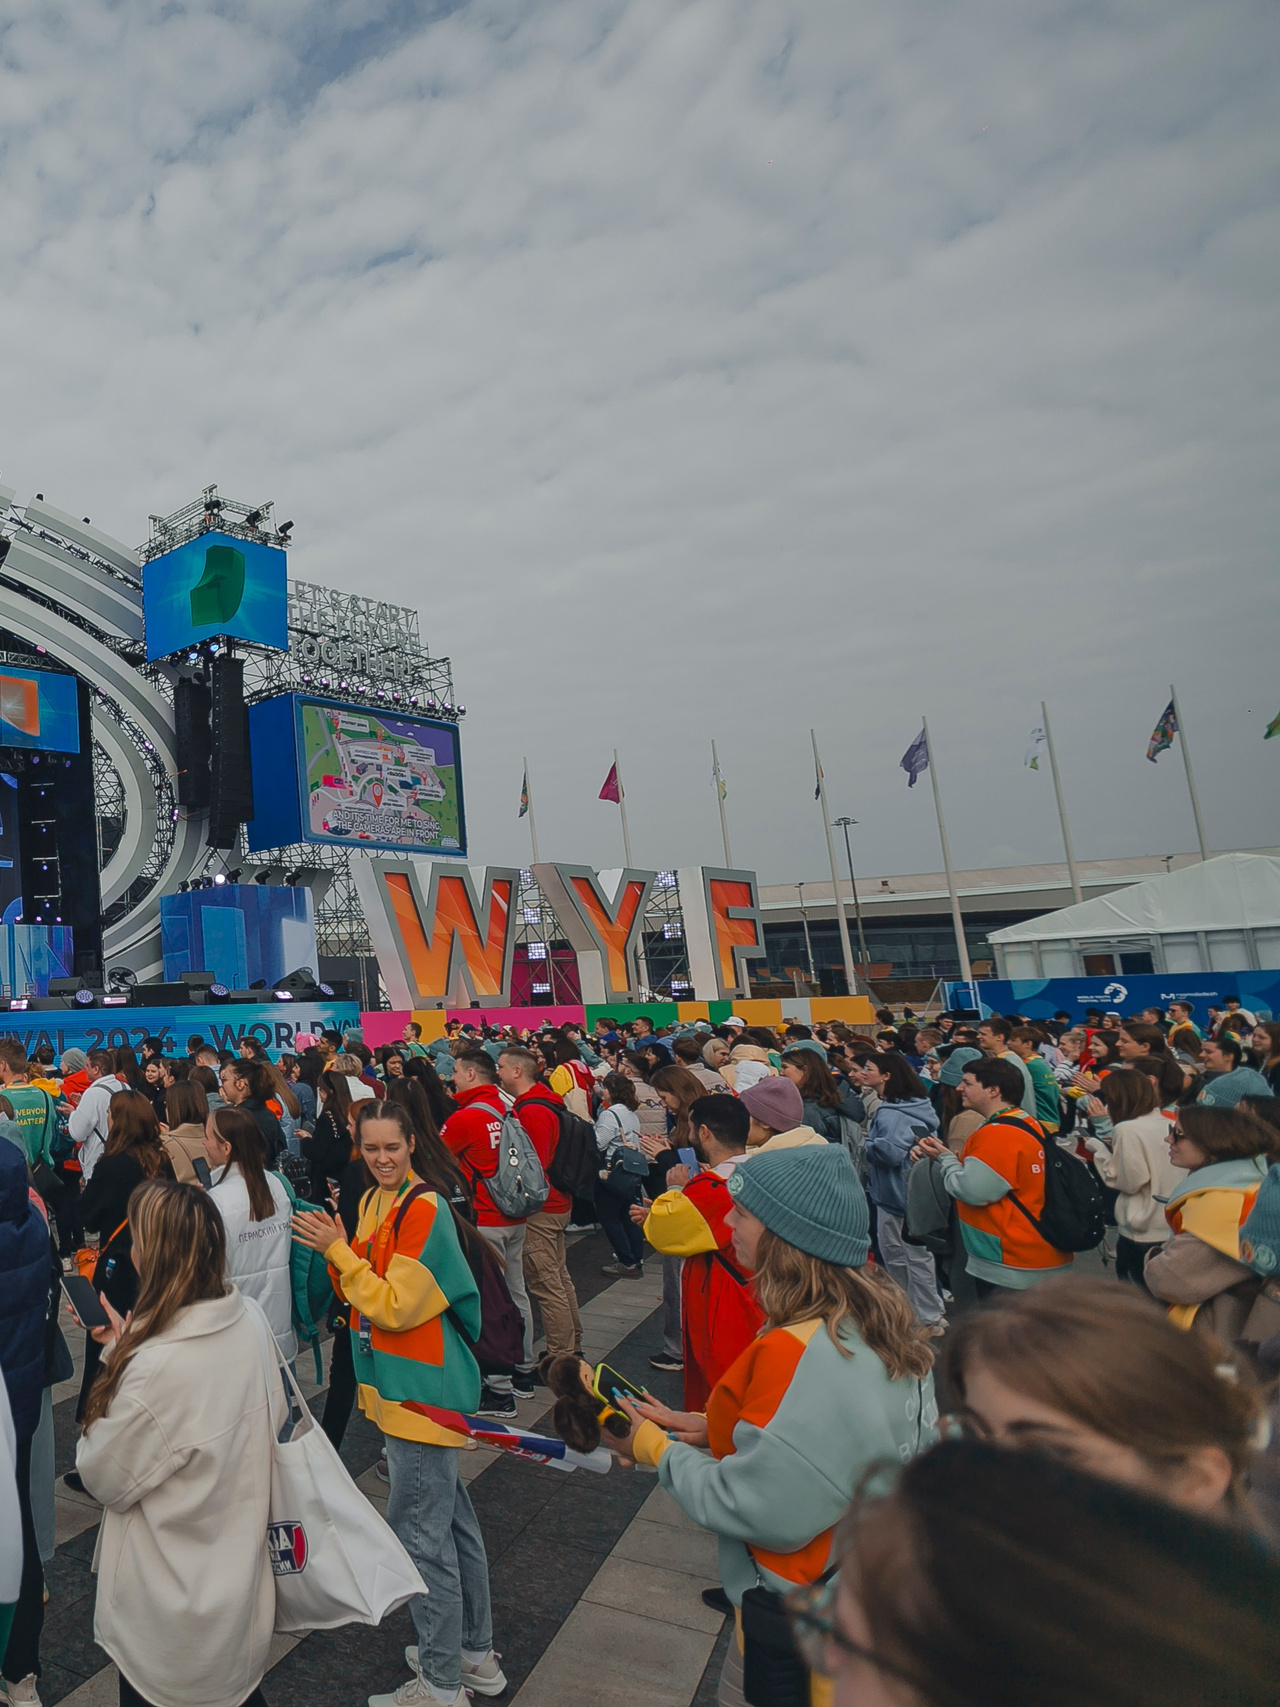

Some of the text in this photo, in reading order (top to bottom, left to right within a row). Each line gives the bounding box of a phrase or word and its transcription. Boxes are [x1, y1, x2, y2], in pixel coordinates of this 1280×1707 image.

[333, 809, 350, 820] AND
[365, 814, 384, 824] TIME
[384, 816, 400, 826] FOR
[401, 819, 412, 827] ME
[412, 819, 423, 828] TO
[337, 821, 439, 839] THE CAMERAS ARE IN FRONT
[350, 858, 766, 1011] WYF
[84, 1027, 178, 1053] 2024
[16, 1107, 46, 1117] VERYON
[238, 1223, 278, 1243] ПЕРМСКИЙ
